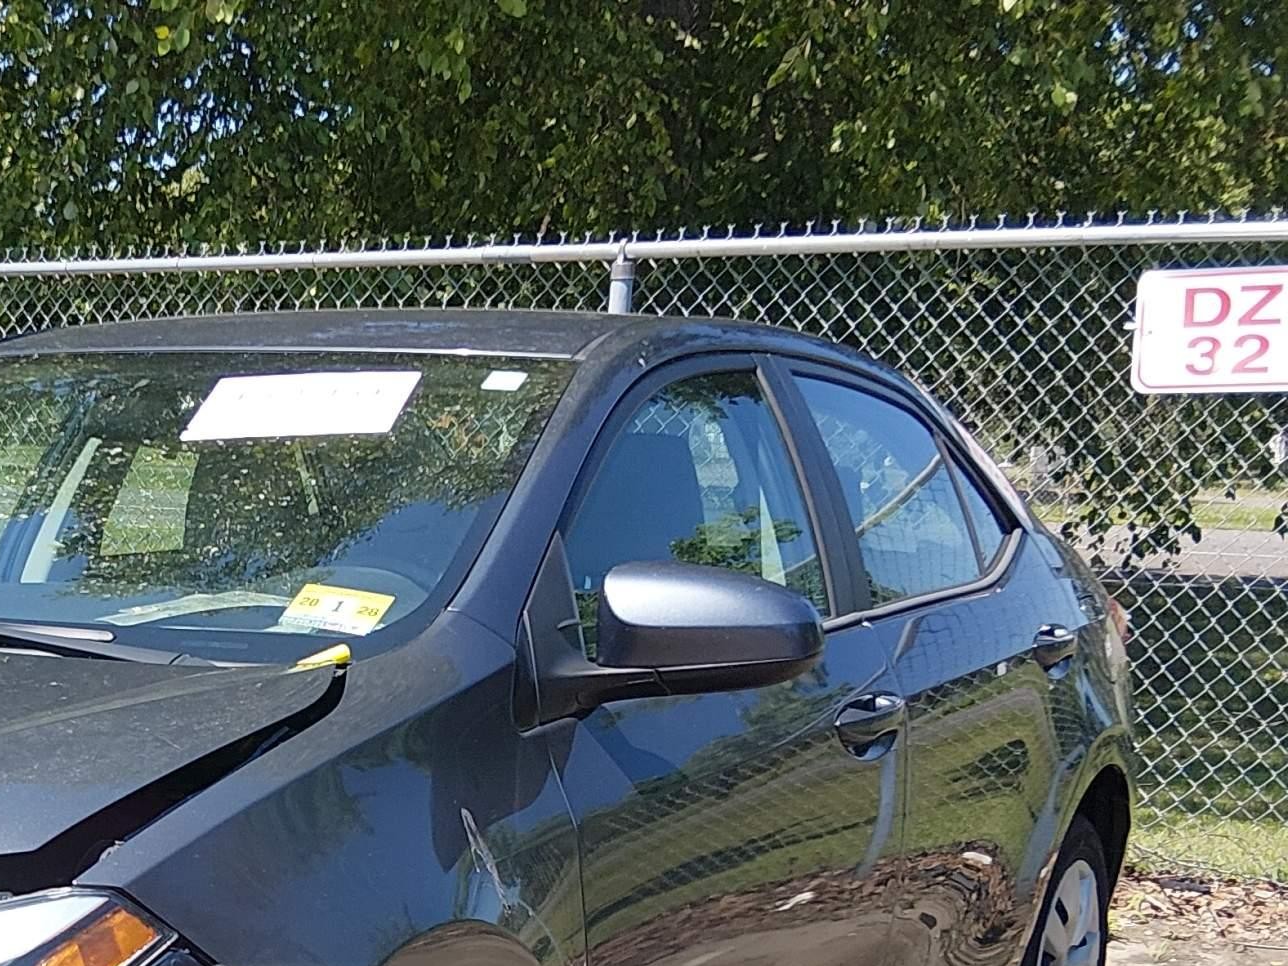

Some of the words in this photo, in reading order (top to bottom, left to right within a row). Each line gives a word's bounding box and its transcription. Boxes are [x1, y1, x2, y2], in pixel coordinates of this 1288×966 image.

[1184, 284, 1283, 328] DZ
[1185, 334, 1270, 376] 32
[299, 597, 320, 607] 20
